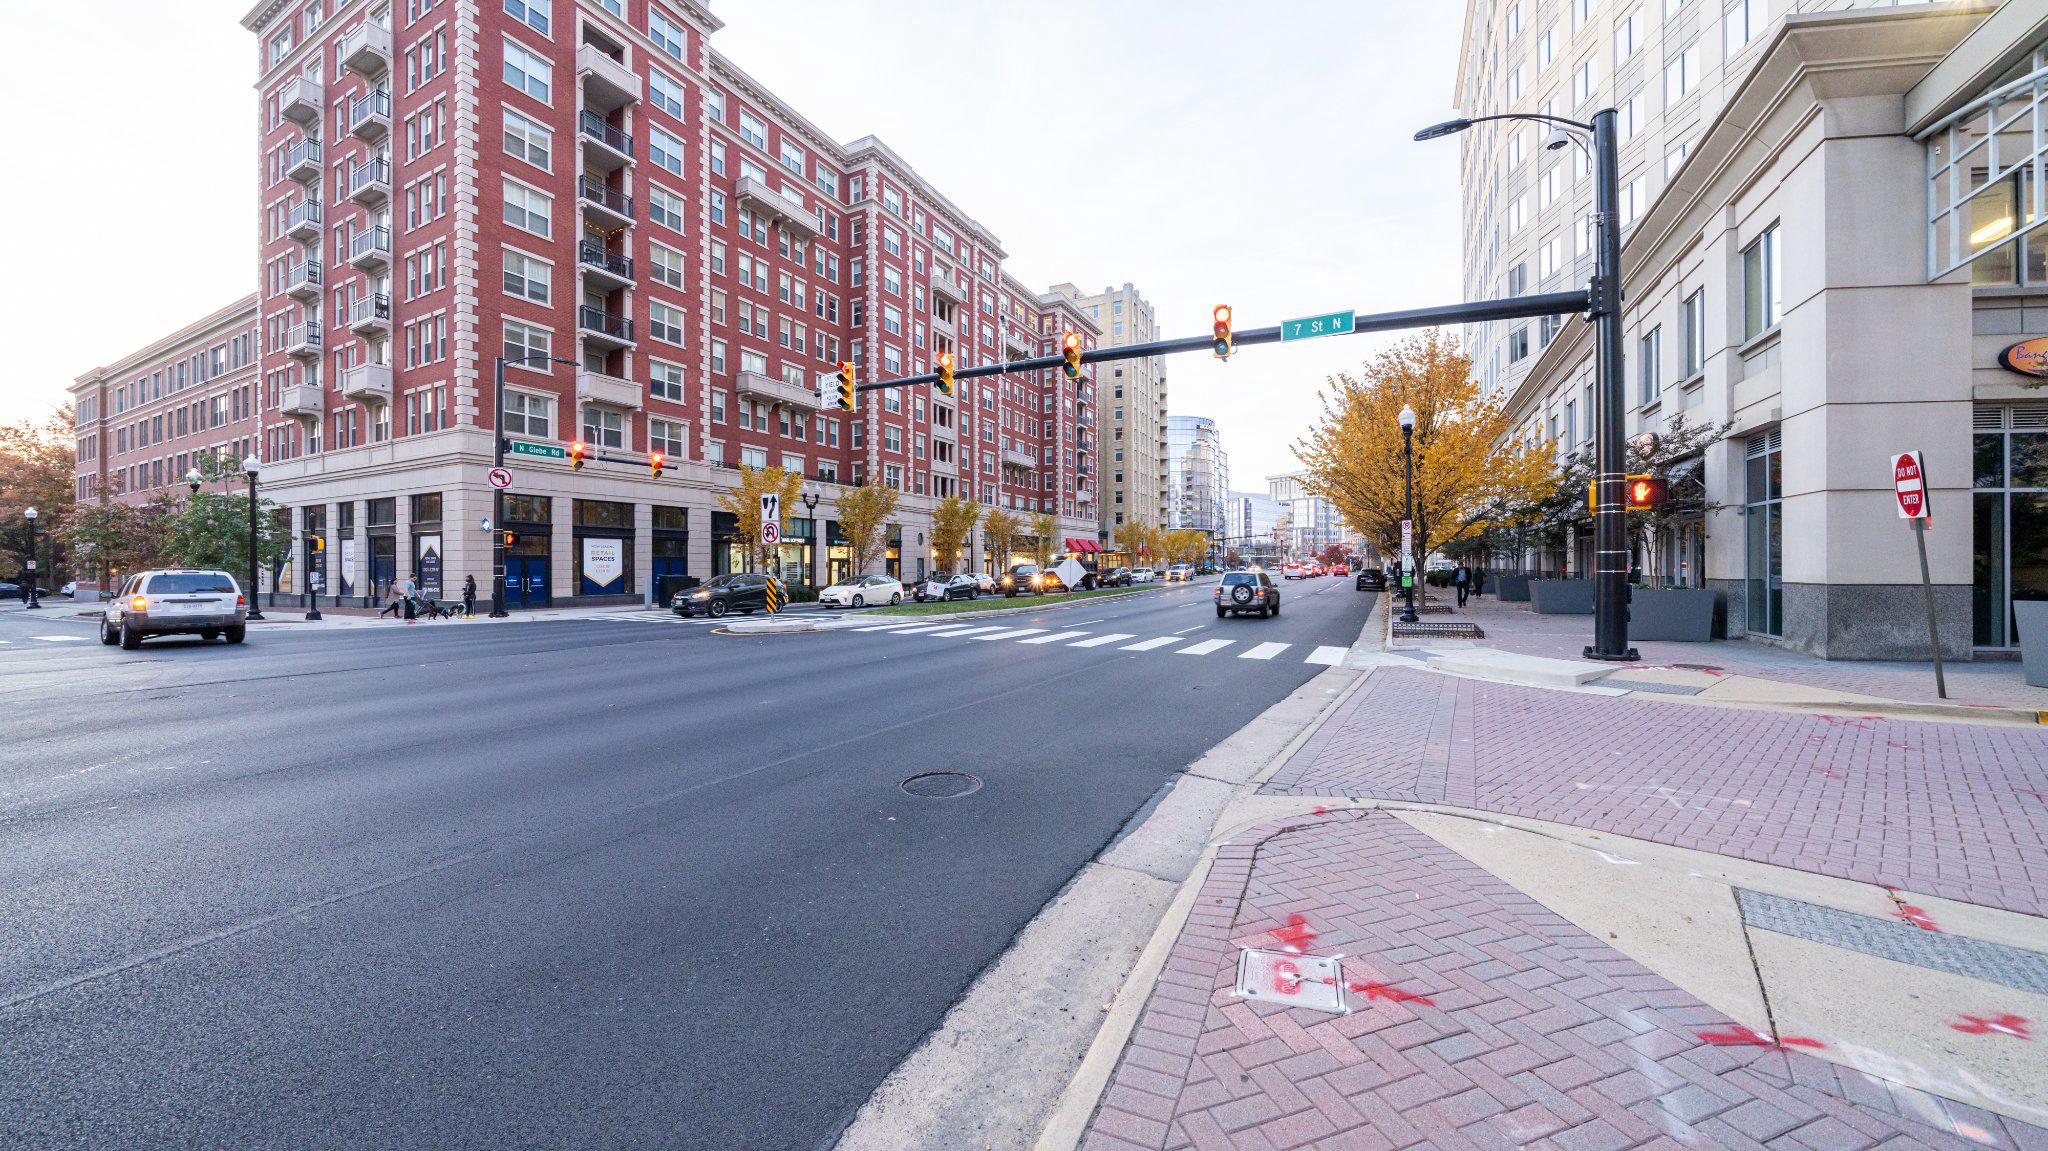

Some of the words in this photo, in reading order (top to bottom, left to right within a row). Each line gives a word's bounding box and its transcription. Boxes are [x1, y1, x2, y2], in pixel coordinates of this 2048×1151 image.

[1294, 323, 1302, 336] 7
[1311, 320, 1323, 333] St
[1333, 317, 1341, 330] N
[825, 380, 840, 389] YIELD
[519, 444, 525, 452] N
[529, 446, 547, 455] Glebe
[551, 448, 560, 457] Rd
[1897, 467, 1906, 478] DO
[1906, 465, 1917, 476] NOT
[1903, 494, 1920, 505] ENTER
